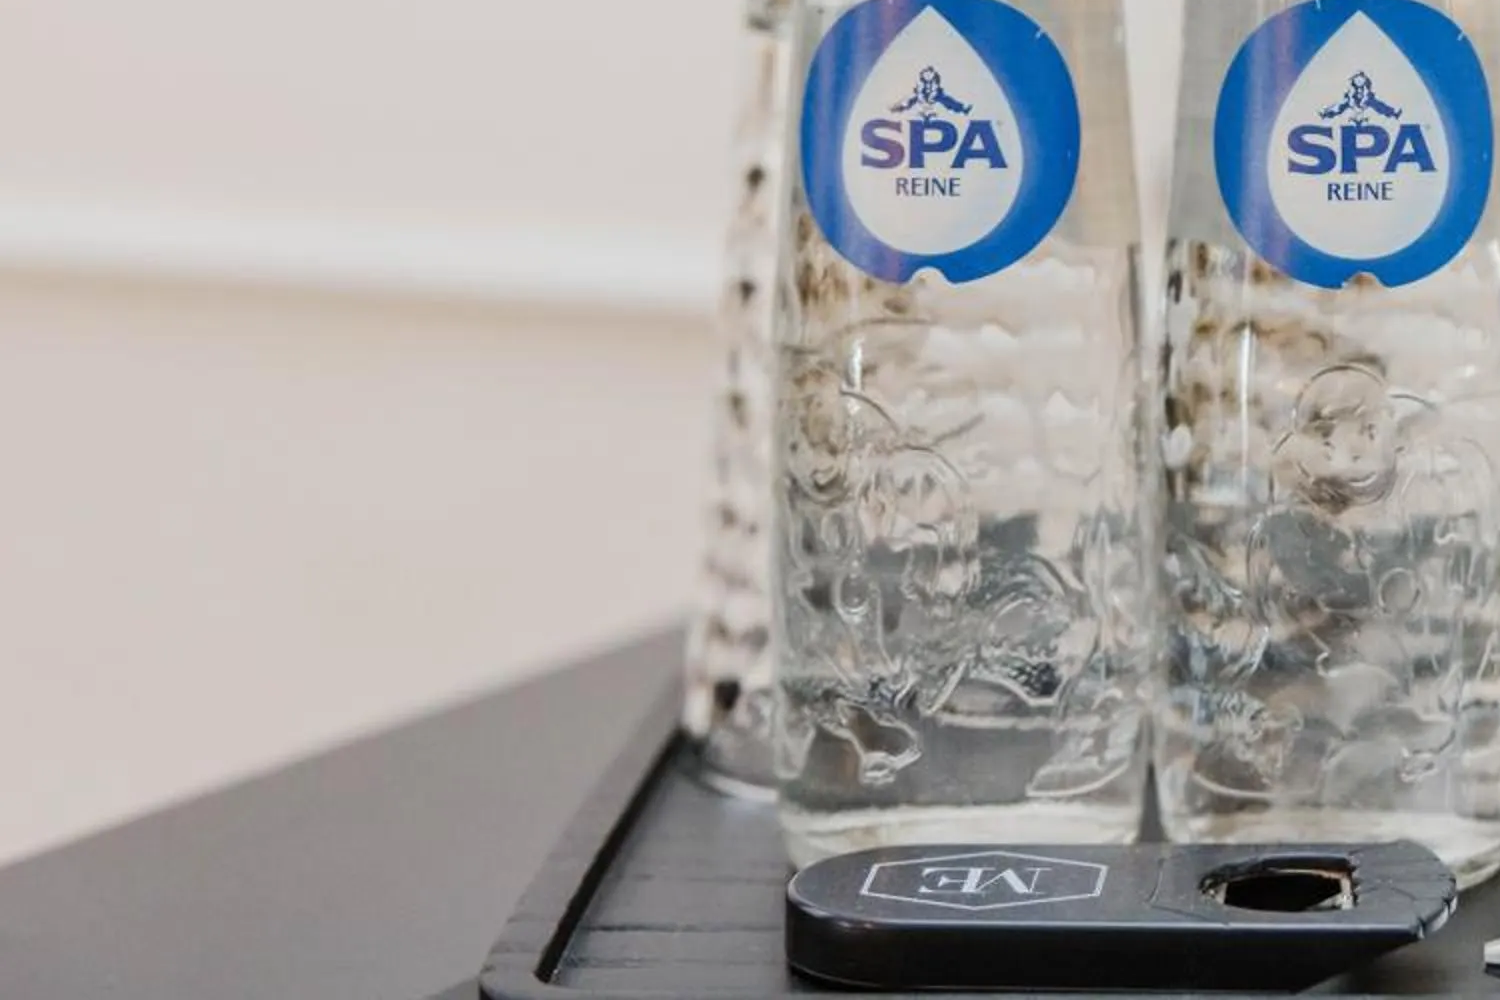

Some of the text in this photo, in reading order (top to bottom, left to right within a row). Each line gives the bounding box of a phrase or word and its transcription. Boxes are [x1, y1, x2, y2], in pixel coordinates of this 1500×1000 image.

[861, 118, 1008, 169] SPA
[1287, 124, 1437, 174] SPA
[895, 177, 961, 196] REINE
[1327, 182, 1395, 201] REINE
